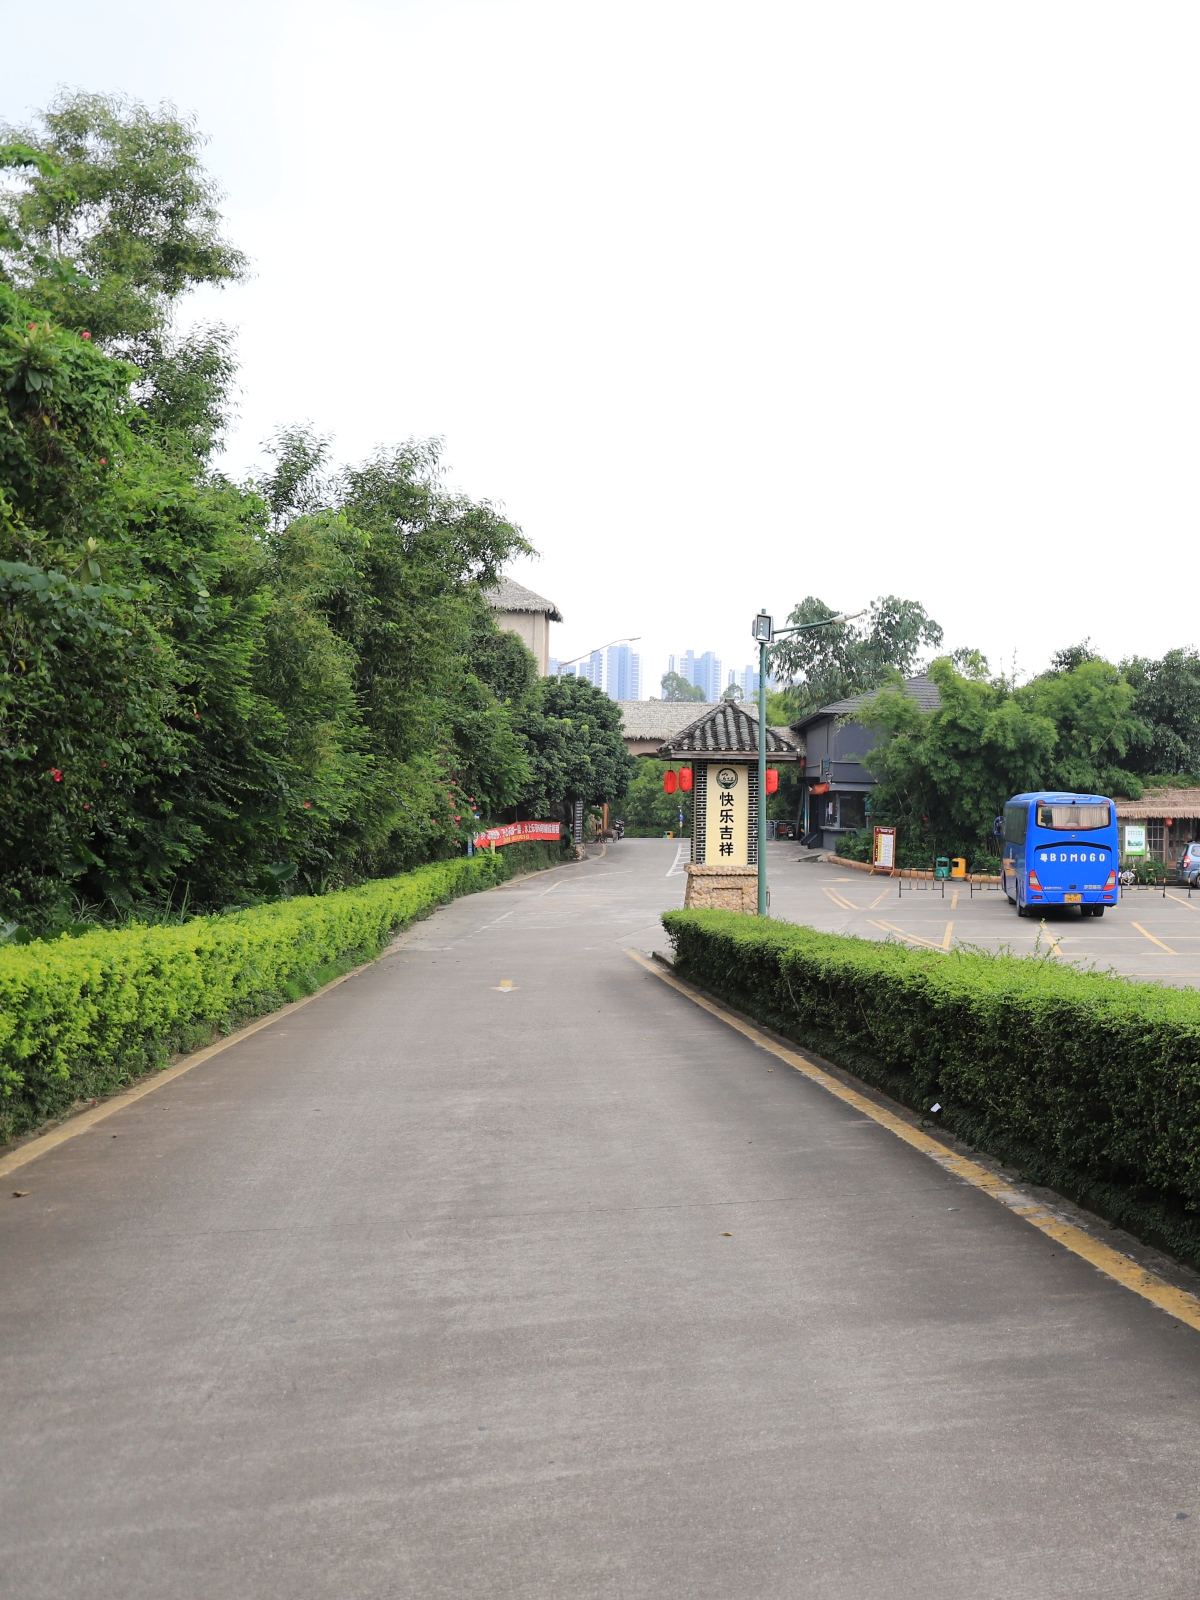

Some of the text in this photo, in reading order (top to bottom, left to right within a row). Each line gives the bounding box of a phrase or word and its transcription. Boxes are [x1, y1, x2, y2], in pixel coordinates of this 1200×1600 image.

[719, 791, 734, 857] 快乐吉祥
[1040, 853, 1106, 862] 粤BDM060
